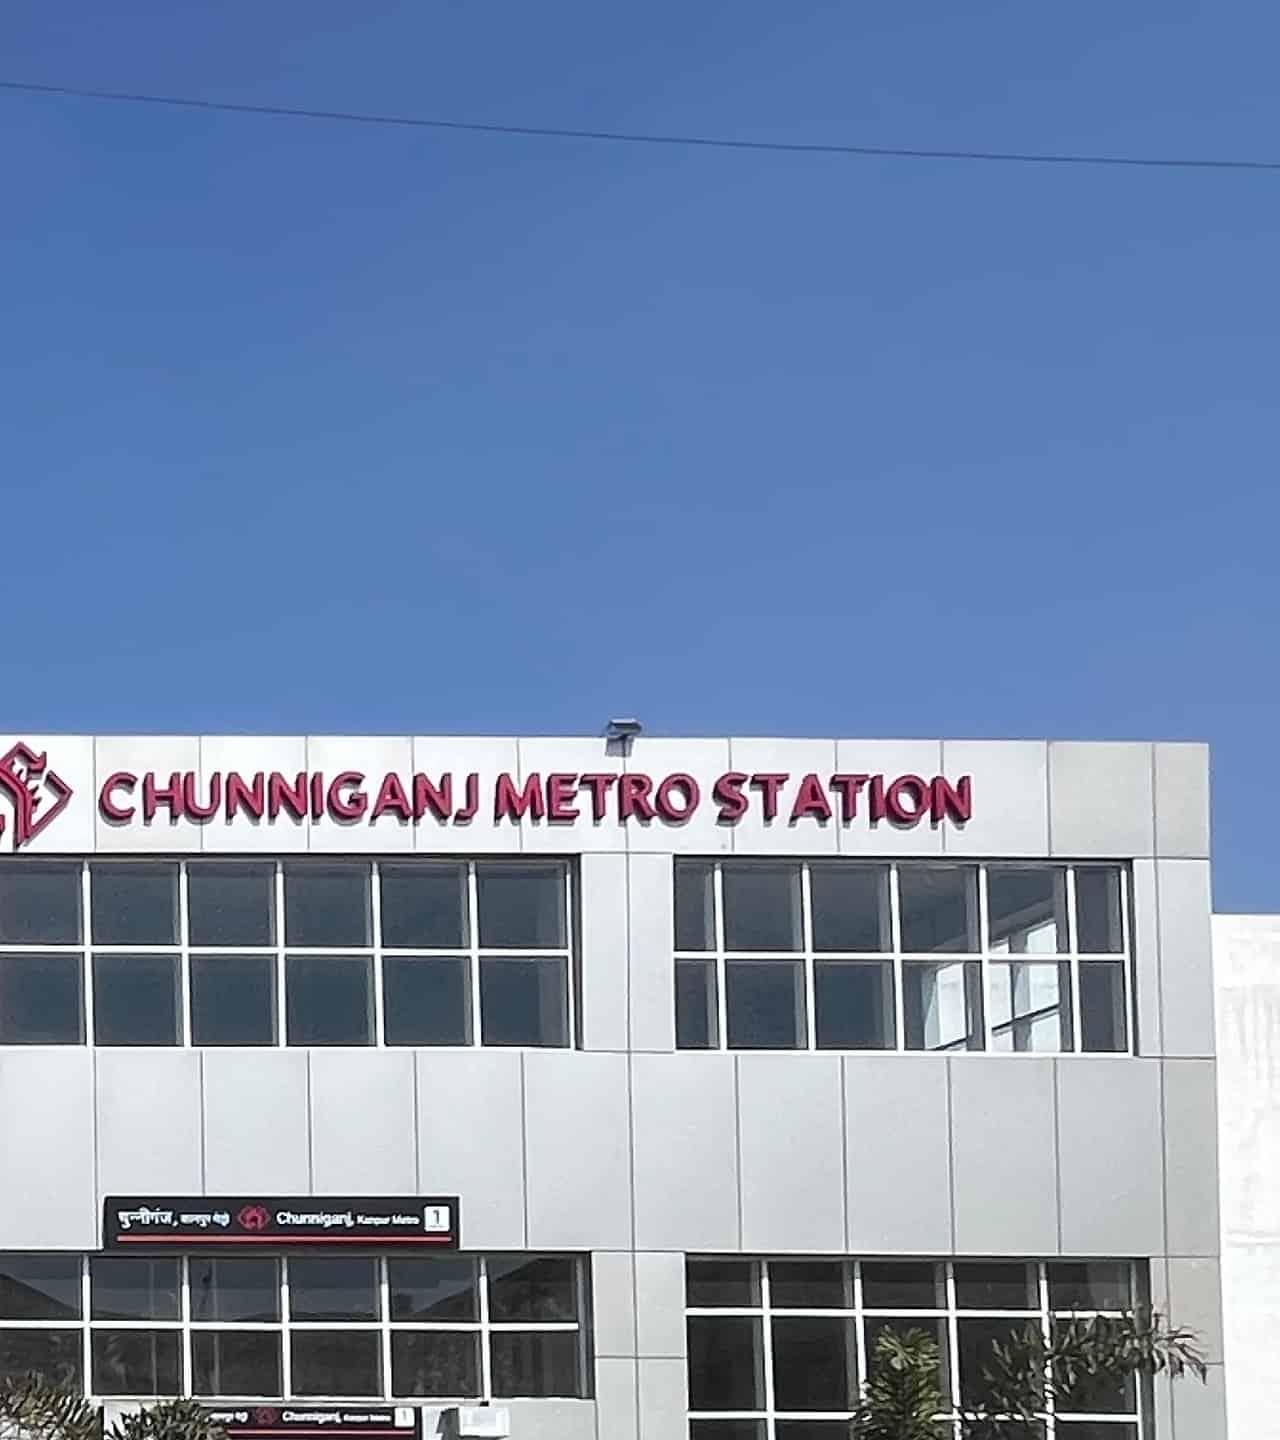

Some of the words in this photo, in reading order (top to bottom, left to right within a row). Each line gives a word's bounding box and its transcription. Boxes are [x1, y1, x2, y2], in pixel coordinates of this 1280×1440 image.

[99, 771, 476, 826] CHUNNIGANJ
[493, 771, 699, 826] METRO
[713, 772, 973, 826] STATION
